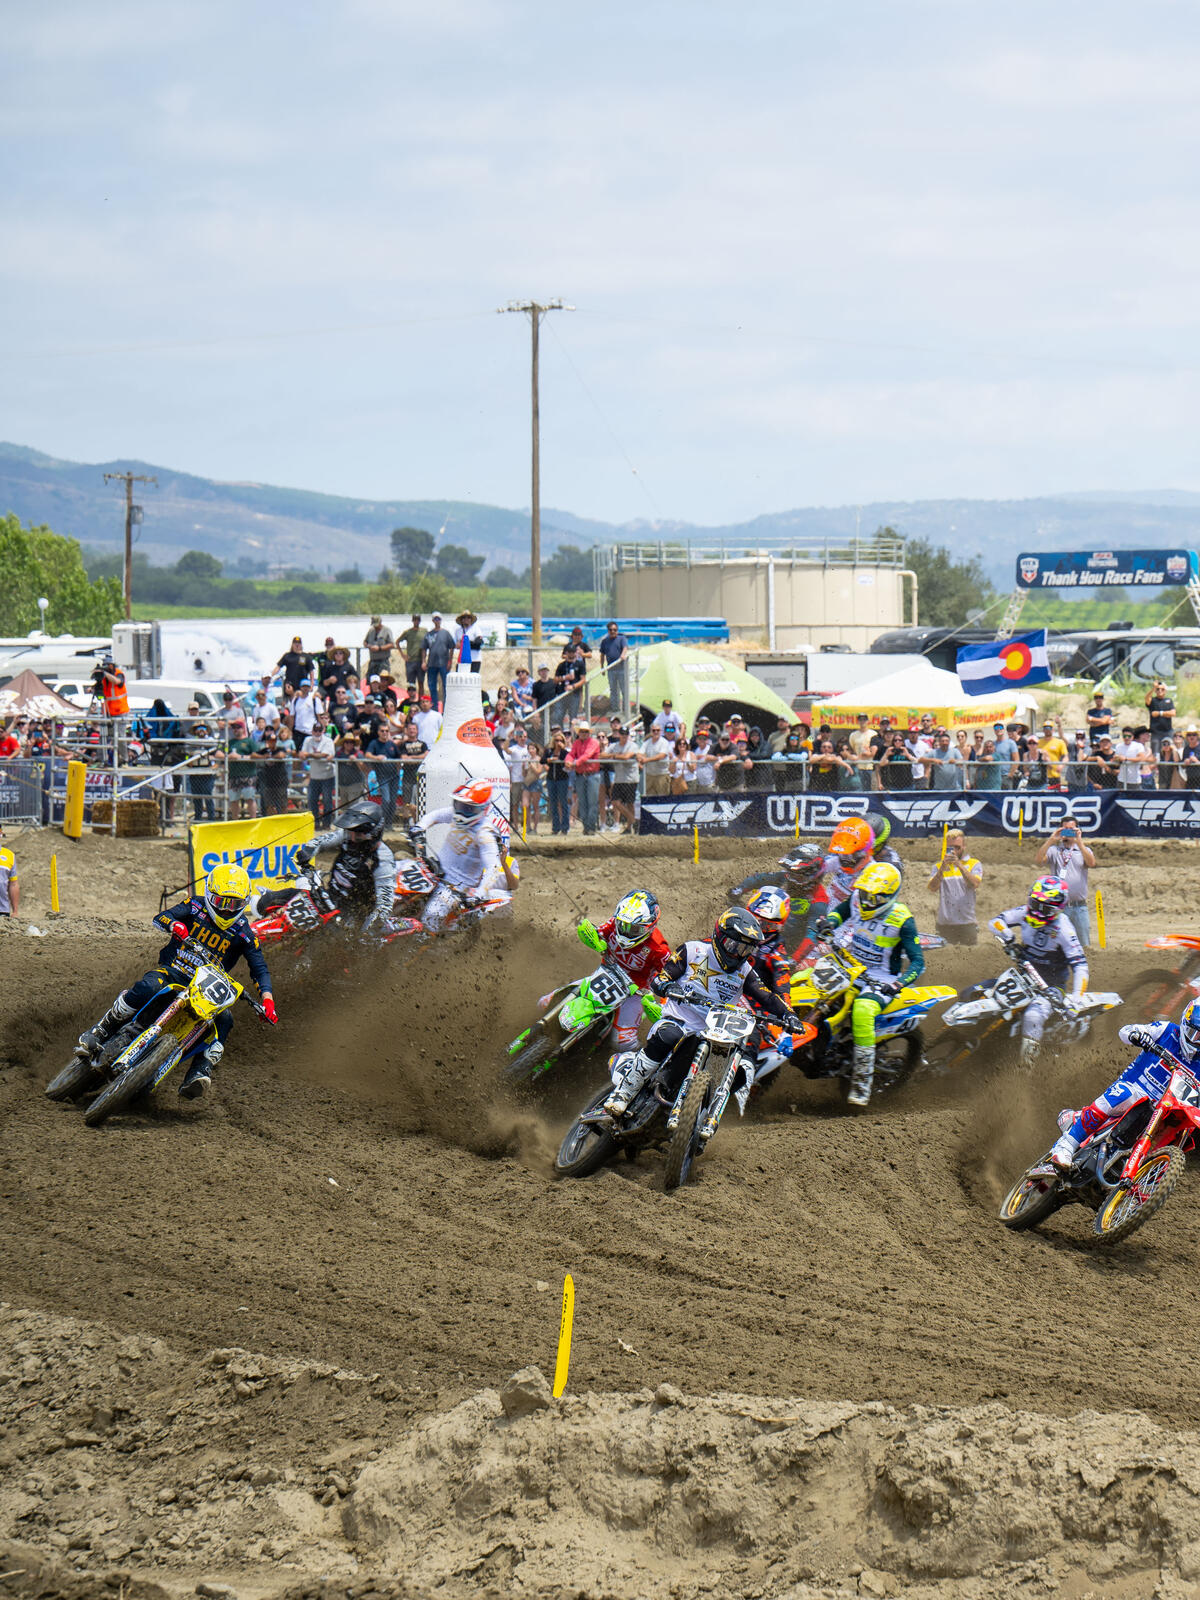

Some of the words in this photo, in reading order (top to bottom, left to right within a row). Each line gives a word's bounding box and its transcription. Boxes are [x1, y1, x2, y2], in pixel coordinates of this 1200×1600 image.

[1041, 570, 1077, 586] Thank
[1080, 571, 1103, 586] You
[1104, 569, 1133, 585] Race
[1134, 569, 1164, 584] Fans
[641, 800, 753, 824] FLY
[767, 795, 870, 832] WPS
[882, 799, 989, 824] FLY
[1002, 795, 1101, 833] WPS
[667, 821, 729, 831] RACING
[904, 821, 967, 829] RACING
[1138, 820, 1200, 829] RACING
[190, 921, 231, 954] THOR
[197, 973, 230, 1005] 19
[590, 973, 626, 1006] 65
[997, 977, 1027, 1007] 84
[712, 1013, 748, 1038] 12
